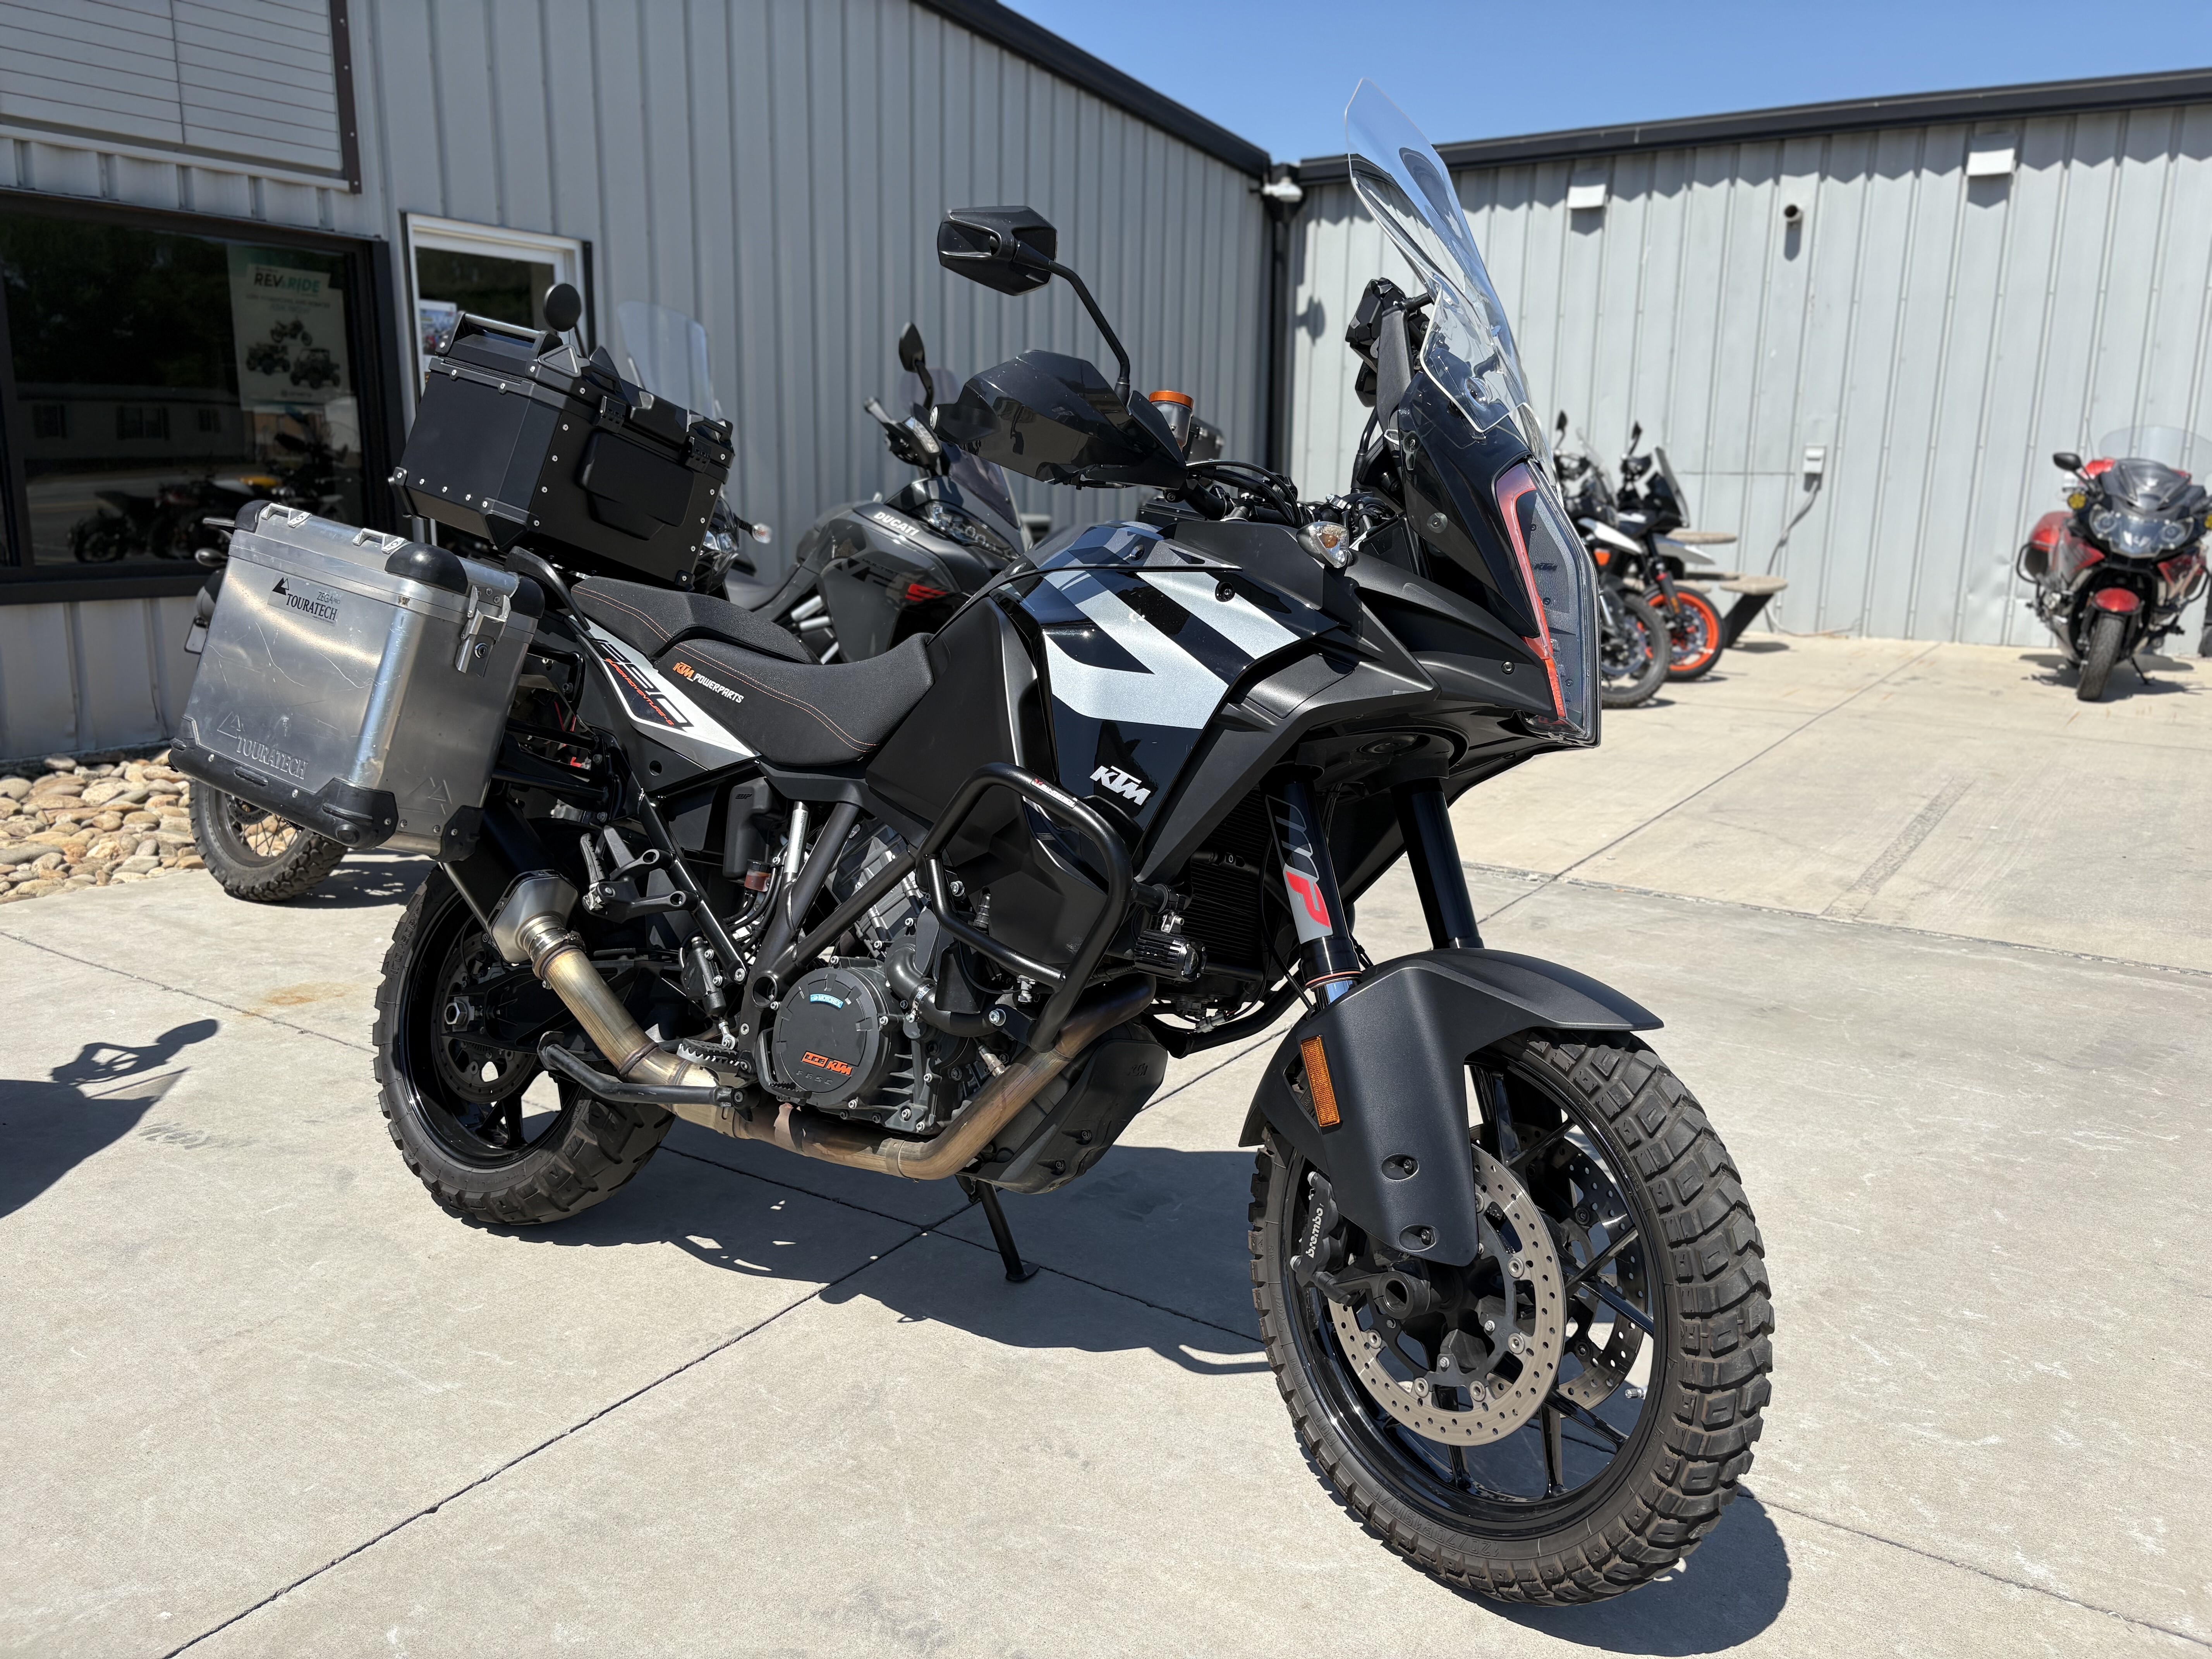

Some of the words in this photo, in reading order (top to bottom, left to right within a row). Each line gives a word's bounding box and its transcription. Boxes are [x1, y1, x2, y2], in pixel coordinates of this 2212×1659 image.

[254, 273, 283, 288] REV
[287, 276, 321, 293] RIDE
[874, 512, 920, 536] DUCATI
[286, 593, 338, 621] TOURATECH
[317, 591, 333, 604] ZEGA
[672, 661, 695, 678] KTM
[693, 673, 744, 704] POWERPARTS
[236, 735, 309, 780] TOURATECH
[1089, 765, 1151, 806] KTM
[826, 1060, 853, 1076] KTM
[1305, 1207, 1323, 1259] brembo
